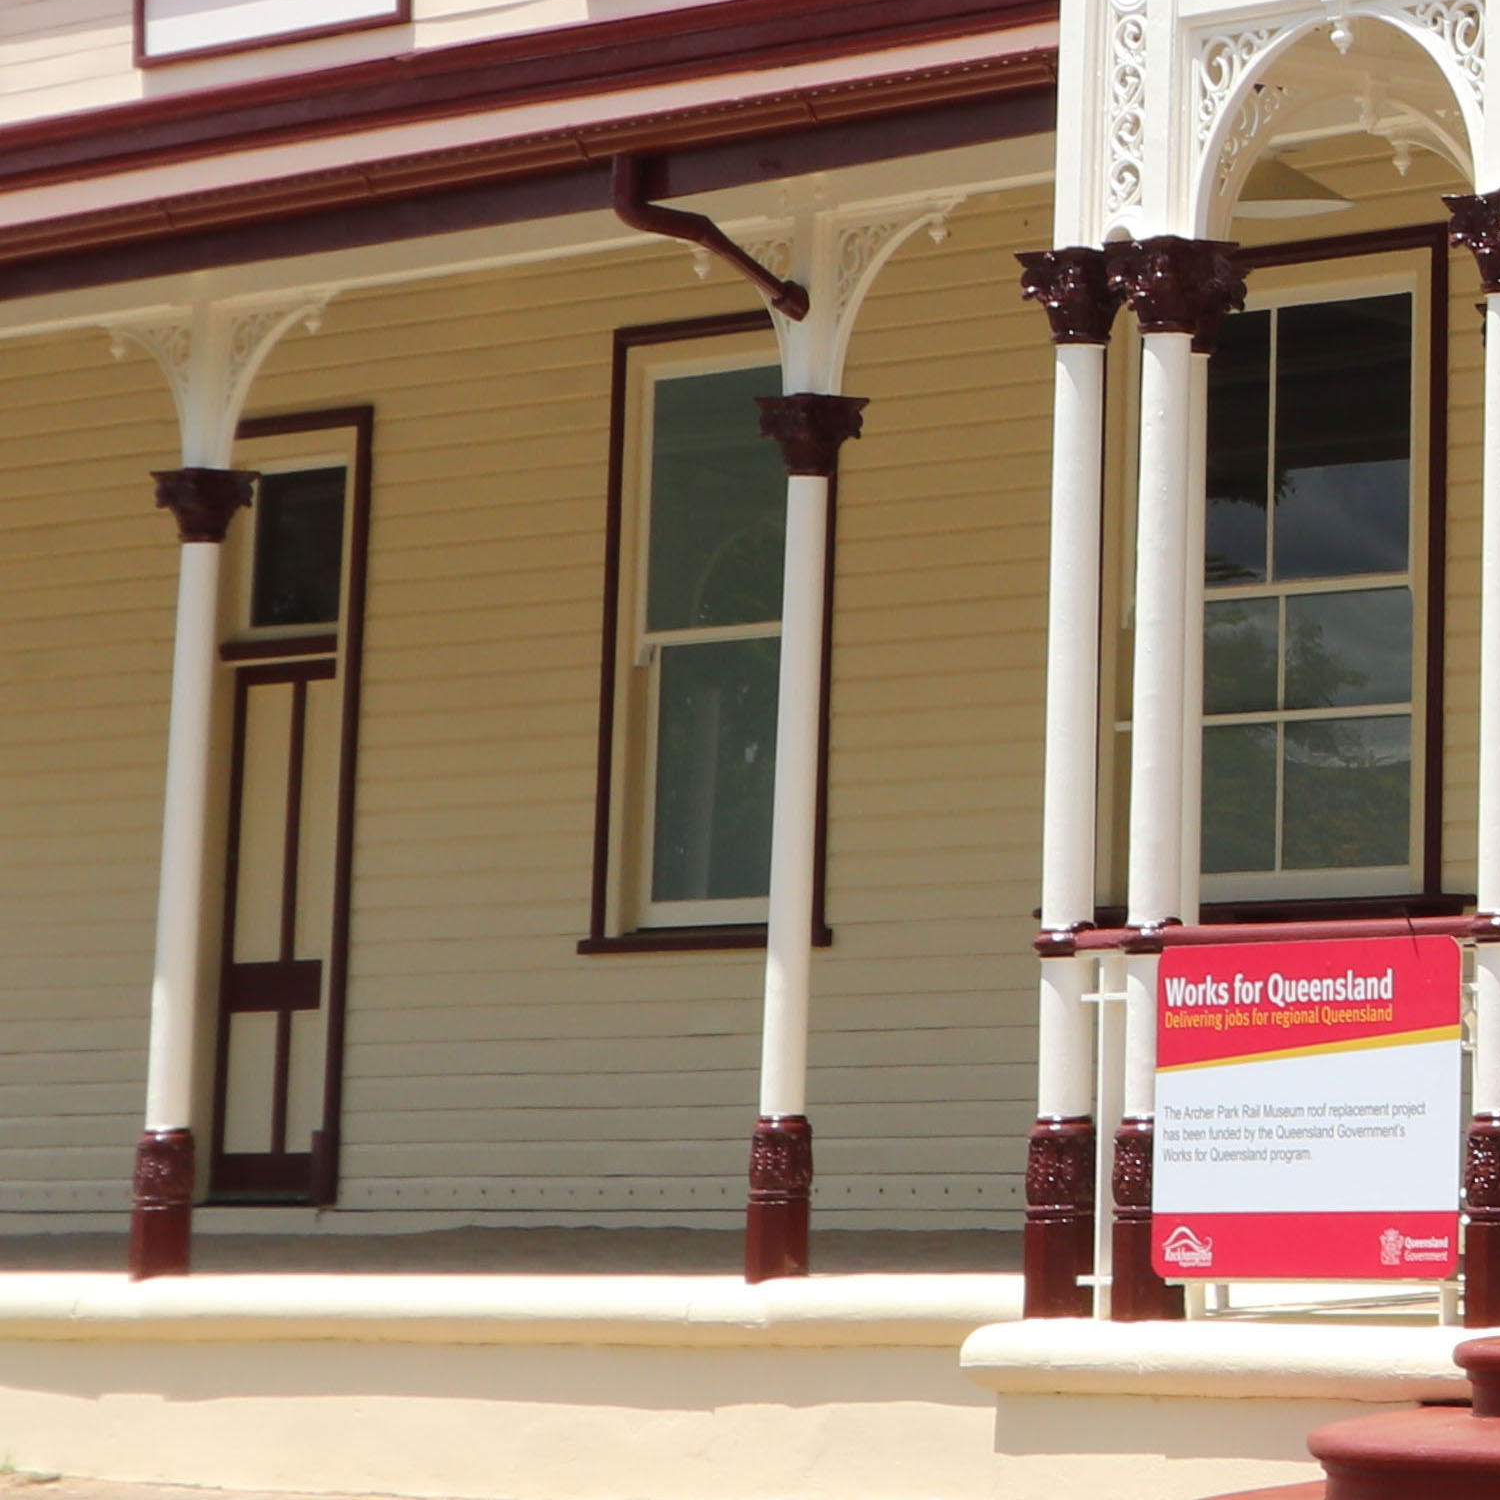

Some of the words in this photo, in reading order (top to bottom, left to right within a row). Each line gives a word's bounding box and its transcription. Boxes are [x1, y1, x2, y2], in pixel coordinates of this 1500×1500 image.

[1164, 975, 1229, 1007] Works
[1234, 973, 1263, 1005] for
[1267, 967, 1393, 1007] Queensland
[1165, 1009, 1223, 1031] Delivering
[1224, 1008, 1249, 1031] jobs
[1251, 1007, 1269, 1025] for
[1271, 1006, 1319, 1028] regional
[1322, 1003, 1393, 1025] Queensland
[1163, 1106, 1181, 1120] The
[1183, 1105, 1215, 1119] Archer
[1217, 1104, 1239, 1119] Park
[1242, 1104, 1260, 1118] Rail
[1263, 1104, 1304, 1118] Museum
[1307, 1102, 1327, 1117] roof
[1329, 1102, 1389, 1120] replacement
[1392, 1101, 1426, 1118] project
[1163, 1128, 1180, 1141] has
[1182, 1127, 1205, 1140] been
[1209, 1126, 1241, 1140] funded
[1244, 1127, 1255, 1143] by
[1258, 1125, 1273, 1139] the
[1275, 1124, 1334, 1140] Queensland
[1337, 1123, 1406, 1138] Government's
[1163, 1148, 1192, 1162] Works
[1195, 1148, 1208, 1160] for
[1210, 1147, 1267, 1161] Queensland
[1270, 1148, 1312, 1164] program.
[1404, 1236, 1448, 1249] Queensland
